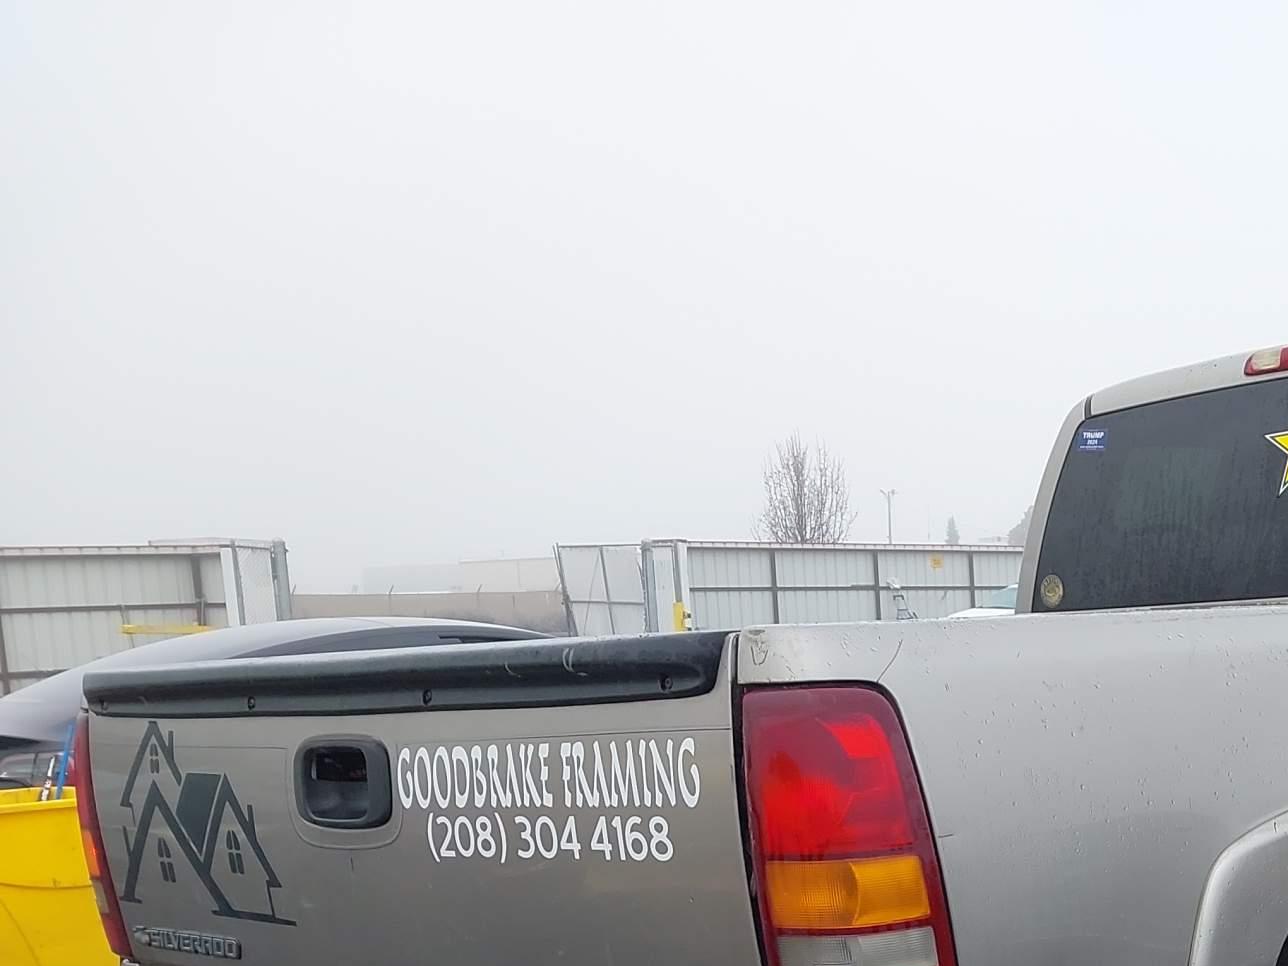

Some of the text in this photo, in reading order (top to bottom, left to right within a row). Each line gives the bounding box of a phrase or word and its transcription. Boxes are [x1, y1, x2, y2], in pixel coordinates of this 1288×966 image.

[1082, 431, 1105, 439] TRUMP
[397, 736, 702, 810] GOODBRAKE FRAMING
[427, 812, 675, 864] (208) 304 4168
[148, 928, 241, 960] SILVERADO
